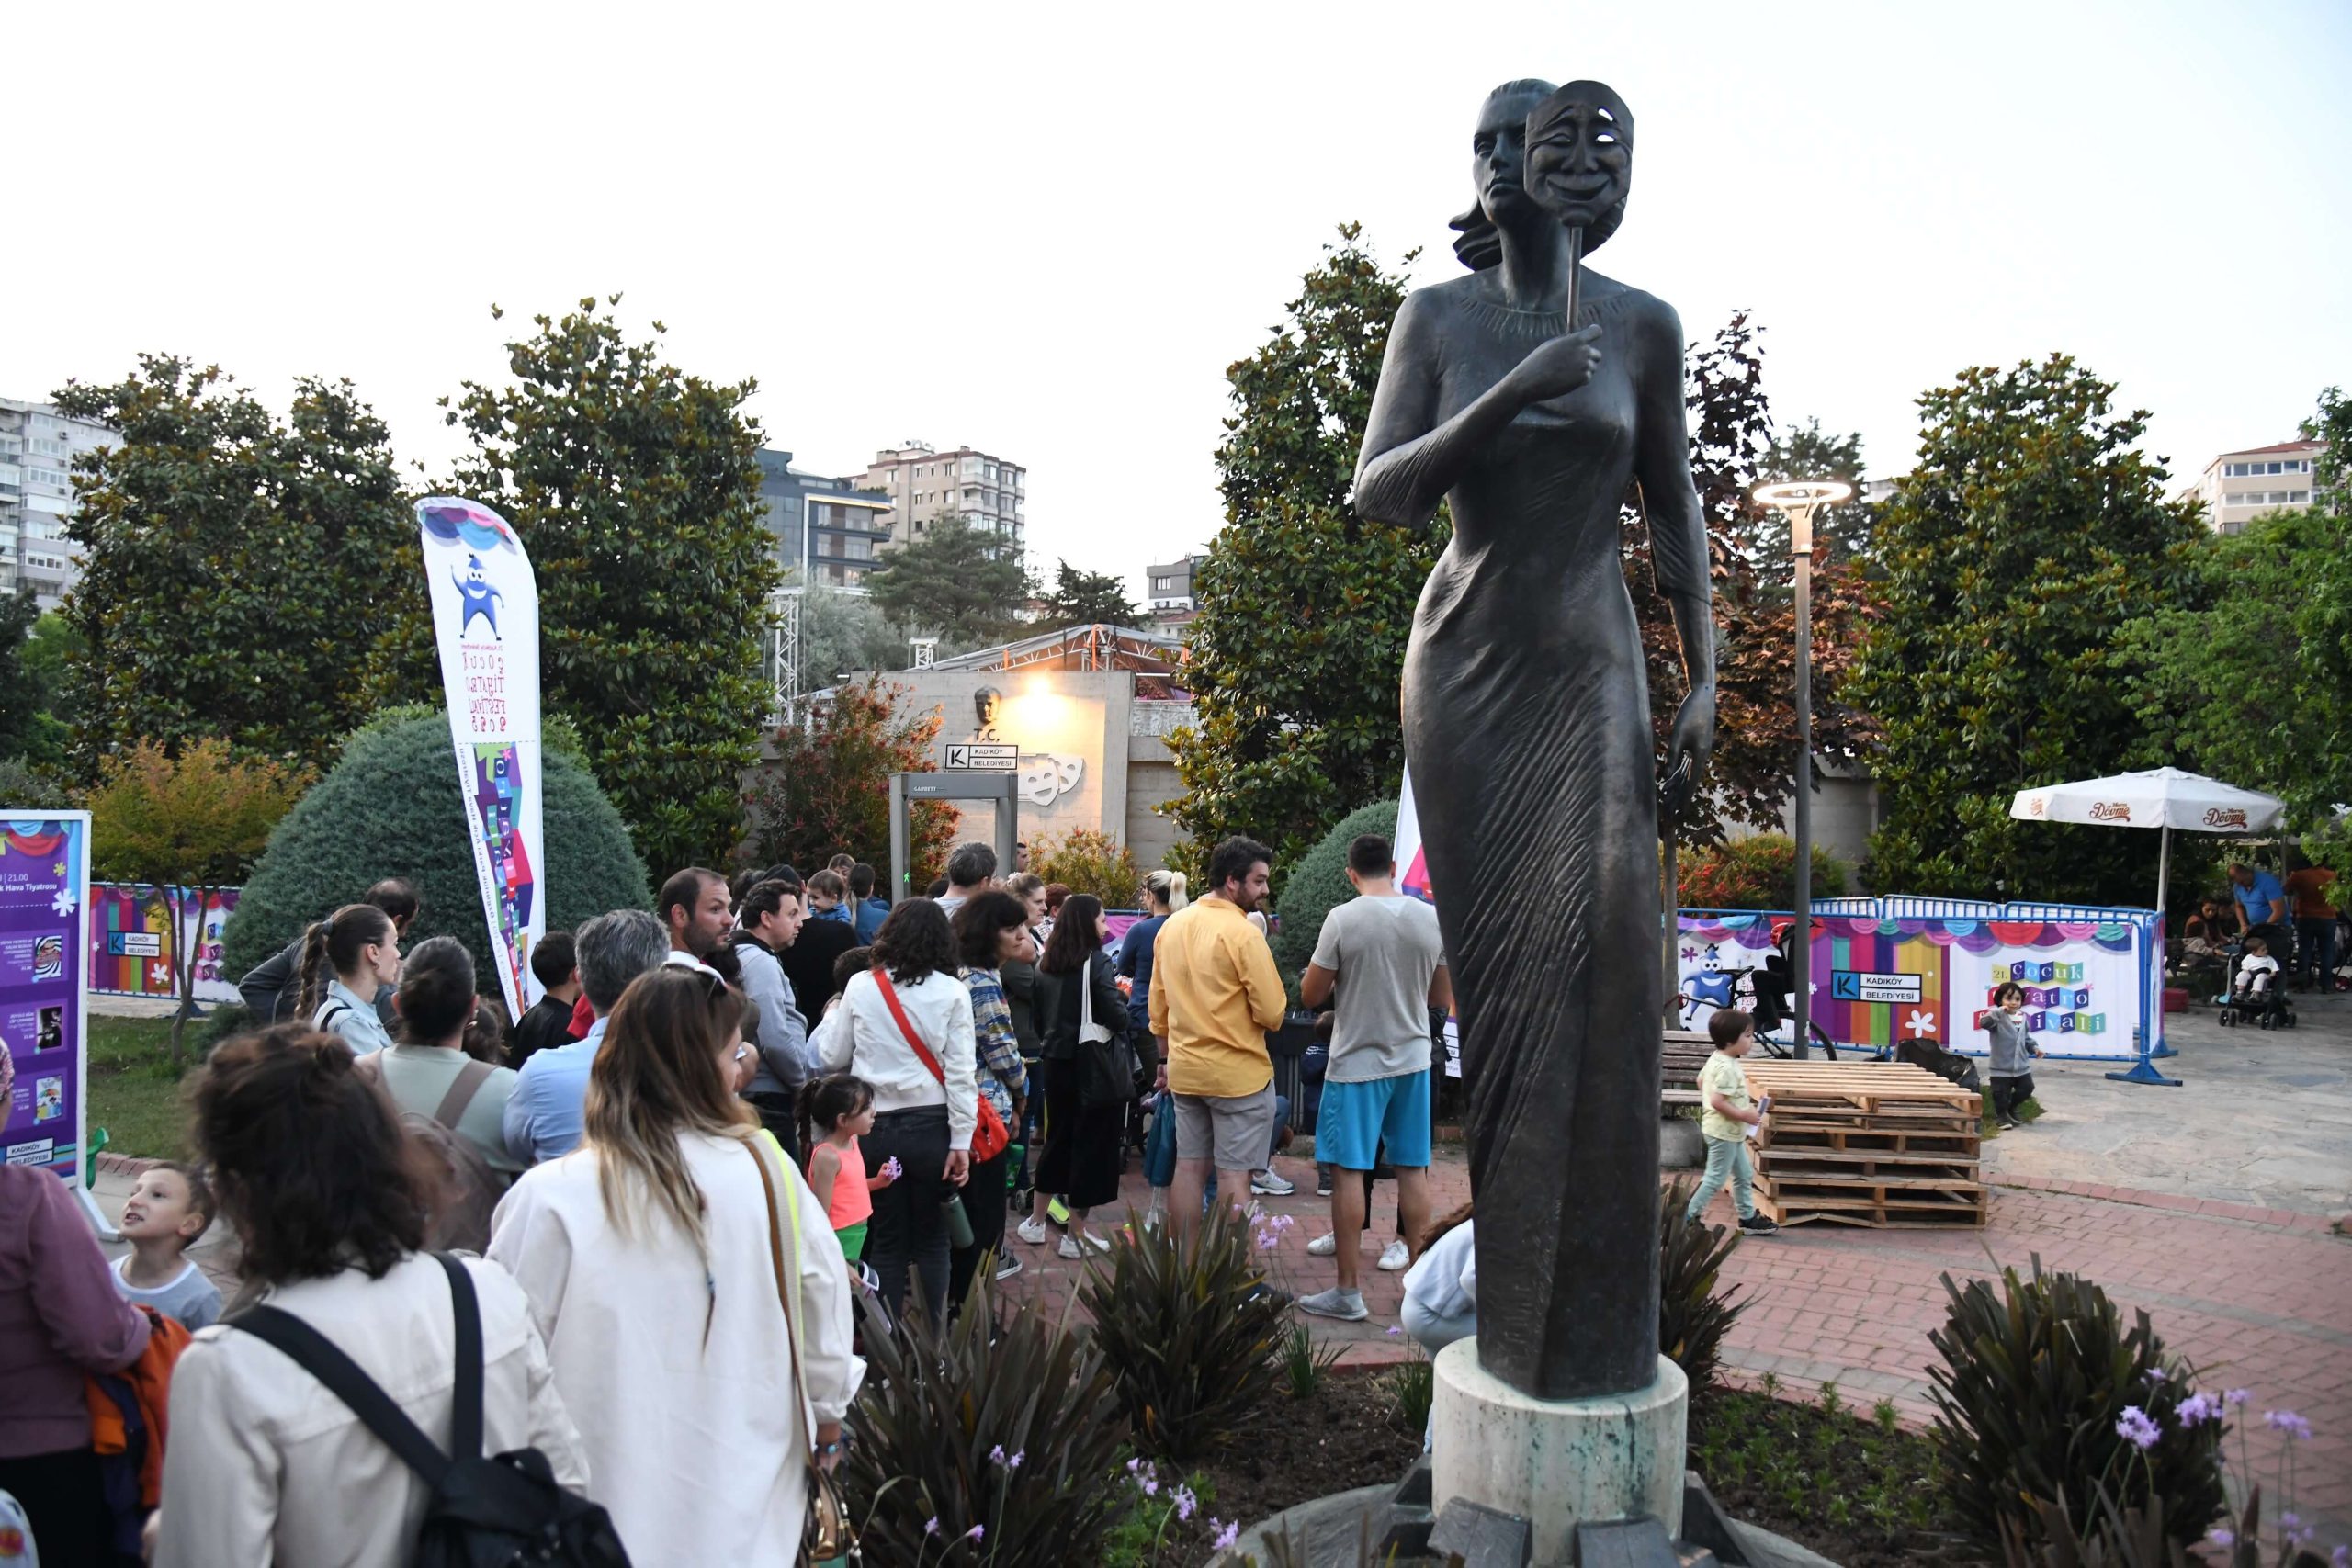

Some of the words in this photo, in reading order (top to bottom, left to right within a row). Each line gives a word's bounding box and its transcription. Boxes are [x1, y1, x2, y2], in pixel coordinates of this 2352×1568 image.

[974, 728, 1000, 741] T.C.
[8, 874, 28, 882] 21.00
[26, 883, 57, 892] Tiyatrosu
[1993, 970, 2007, 979] 21.
[1866, 976, 1903, 986] KADIKÖY
[1866, 991, 1915, 1000] BELEDİYESİ
[11, 1143, 40, 1154] KADIKÖY
